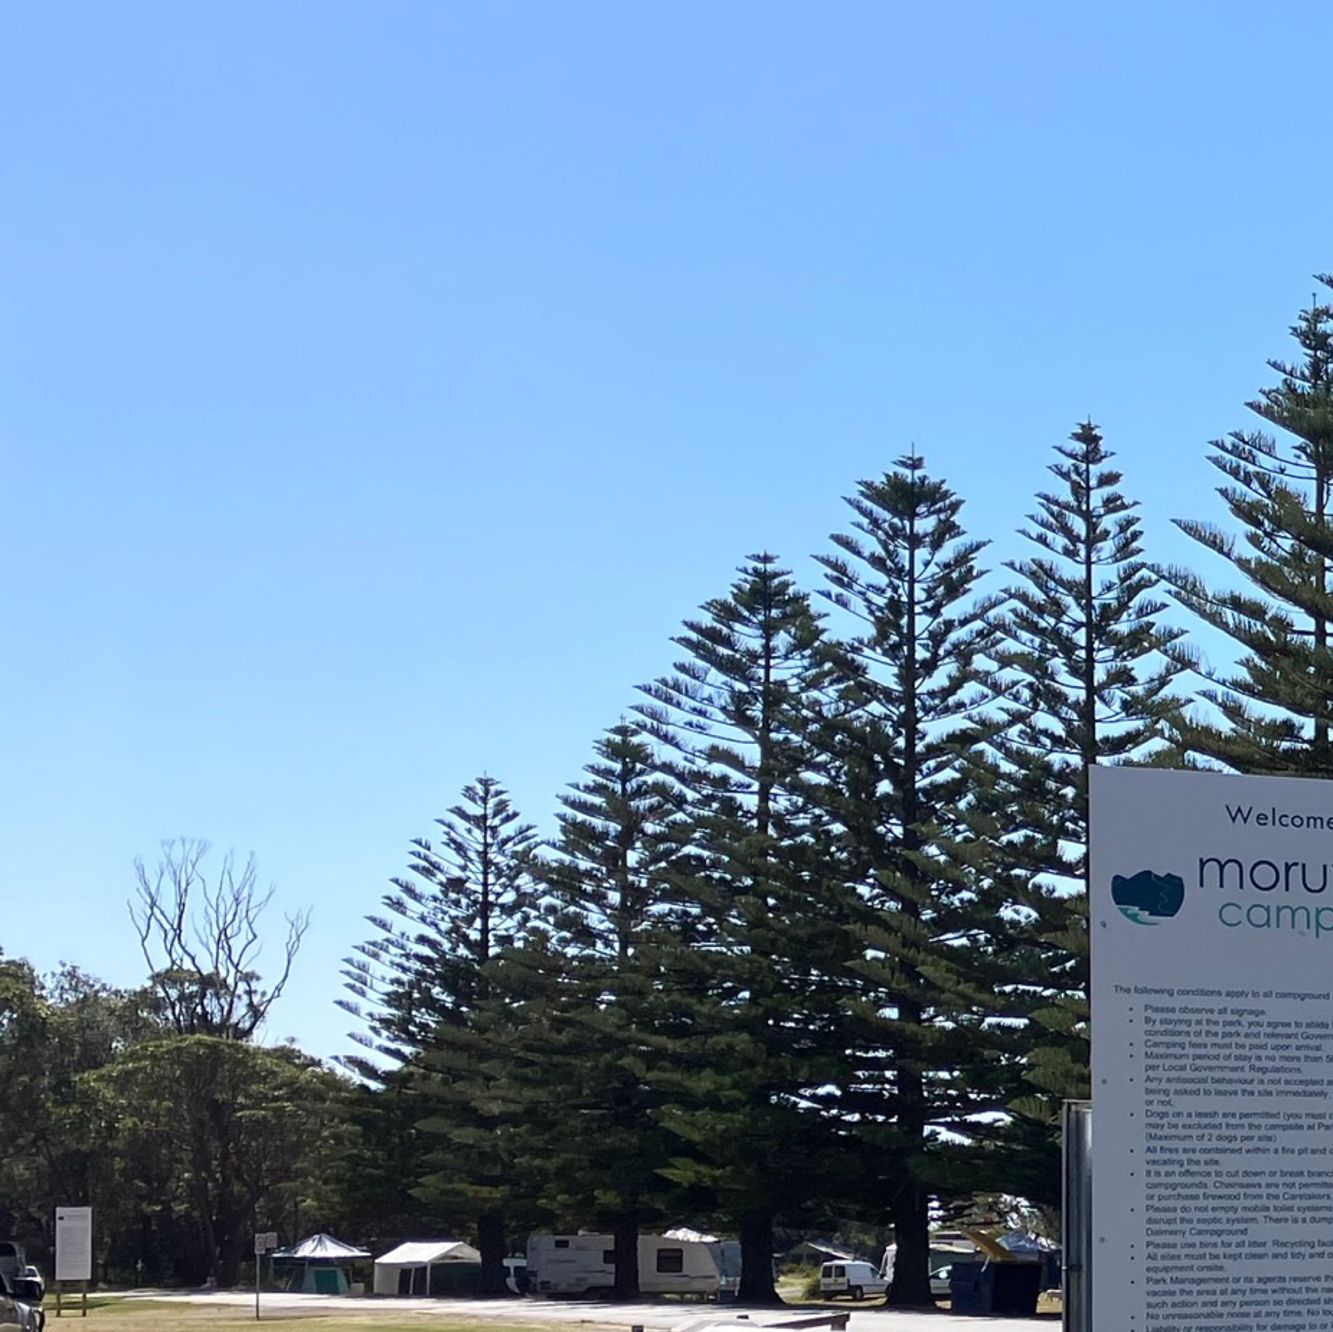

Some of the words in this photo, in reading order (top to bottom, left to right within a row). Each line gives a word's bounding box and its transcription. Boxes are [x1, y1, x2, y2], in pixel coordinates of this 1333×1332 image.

[1114, 986, 1131, 994] The
[1133, 986, 1174, 997] following
[1176, 987, 1222, 996] conditions
[1224, 989, 1248, 999] apply
[1262, 990, 1272, 998] all
[1275, 990, 1330, 1001] campground
[1144, 1005, 1176, 1013] Please
[1178, 1005, 1214, 1014] observe
[1217, 1006, 1228, 1014] all
[1159, 1017, 1192, 1027] staying
[1205, 1018, 1220, 1026] the
[1247, 1020, 1264, 1029] you
[1266, 1021, 1291, 1029] agree
[1305, 1020, 1329, 1028] abide
[1144, 1028, 1191, 1037] conditions
[1221, 1030, 1241, 1040] park
[1243, 1030, 1261, 1038] and
[1263, 1031, 1298, 1039] relevant
[1144, 1040, 1186, 1050] Camping
[1188, 1040, 1208, 1049] fees
[1210, 1041, 1232, 1049] must
[1248, 1041, 1268, 1051] paid
[1270, 1043, 1292, 1052] upon
[1144, 1064, 1160, 1073] per
[1162, 1063, 1187, 1071] Local
[1189, 1063, 1245, 1072] Government
[1145, 1133, 1193, 1142] (Maximum
[1215, 1133, 1237, 1142] dogs
[1240, 1134, 1254, 1142] per
[1257, 1133, 1276, 1142] site)
[1145, 1157, 1184, 1167] vacating
[1186, 1157, 1201, 1165] the
[1212, 1180, 1262, 1188] Chainsaws
[1282, 1180, 1296, 1188] not
[1157, 1192, 1200, 1201] purchase
[1202, 1192, 1241, 1200] firewood
[1242, 1192, 1263, 1200] from
[1265, 1192, 1280, 1200] the
[1188, 1227, 1248, 1237] Campground
[1145, 1240, 1177, 1248] Please
[1198, 1240, 1218, 1248] bins
[1220, 1240, 1232, 1248] for
[1234, 1240, 1245, 1248] all
[1271, 1239, 1315, 1249] Recycling
[1145, 1264, 1194, 1274] equipment
[1162, 1310, 1224, 1319] unreasonable
[1226, 1309, 1251, 1318] noise
[1264, 1310, 1280, 1319] any
